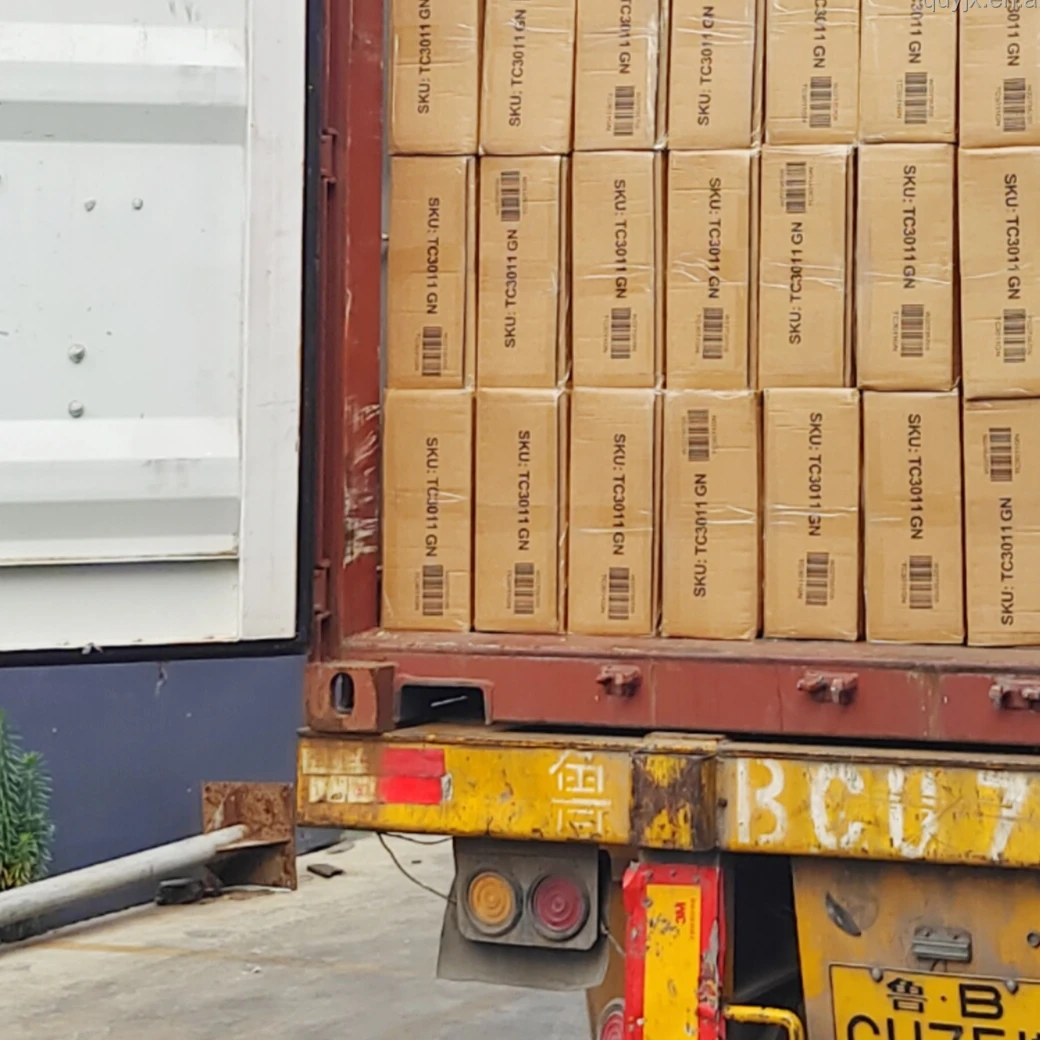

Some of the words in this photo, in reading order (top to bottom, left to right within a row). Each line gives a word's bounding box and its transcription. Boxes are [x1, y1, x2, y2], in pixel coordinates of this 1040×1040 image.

[418, 24, 432, 75] TC3011
[908, 40, 922, 64] GN
[417, 77, 431, 114] SKU:
[613, 179, 627, 215] SKU:
[708, 177, 722, 215] SKU:
[902, 164, 917, 203] SKU:
[1003, 173, 1019, 213] SKU:
[427, 197, 440, 233] SKU:
[790, 221, 804, 246] GN
[902, 206, 917, 261] TC3011
[506, 229, 519, 252] GN
[614, 219, 629, 274] TC3011
[707, 218, 722, 272] TC3011
[1005, 215, 1020, 272] TC3011
[425, 236, 440, 288] TC3011
[789, 249, 803, 303] TC3011
[902, 264, 917, 289] GN
[504, 255, 518, 309] TC3011
[615, 276, 628, 299] GN
[707, 275, 721, 299] GN
[1007, 275, 1022, 300] GN
[425, 291, 438, 315] GN
[504, 311, 517, 349] SKU:
[788, 306, 802, 345] SKU:
[518, 430, 531, 467] SKU:
[808, 412, 823, 450] SKU:
[907, 413, 922, 453] SKU:
[612, 433, 626, 471] SKU:
[517, 470, 531, 524] TC3011
[612, 473, 626, 528] TC3011
[694, 473, 708, 497] GN
[807, 453, 822, 513] TC3011
[908, 455, 924, 512] TC3011
[694, 501, 709, 556] TC3011
[807, 515, 822, 537] GN
[909, 515, 924, 540] GN
[999, 497, 1013, 522] GN
[517, 527, 530, 551] GN
[612, 531, 625, 556] GN
[1000, 525, 1014, 583] TC3011
[693, 558, 708, 598] SKU:
[1000, 585, 1015, 626] SKU:
